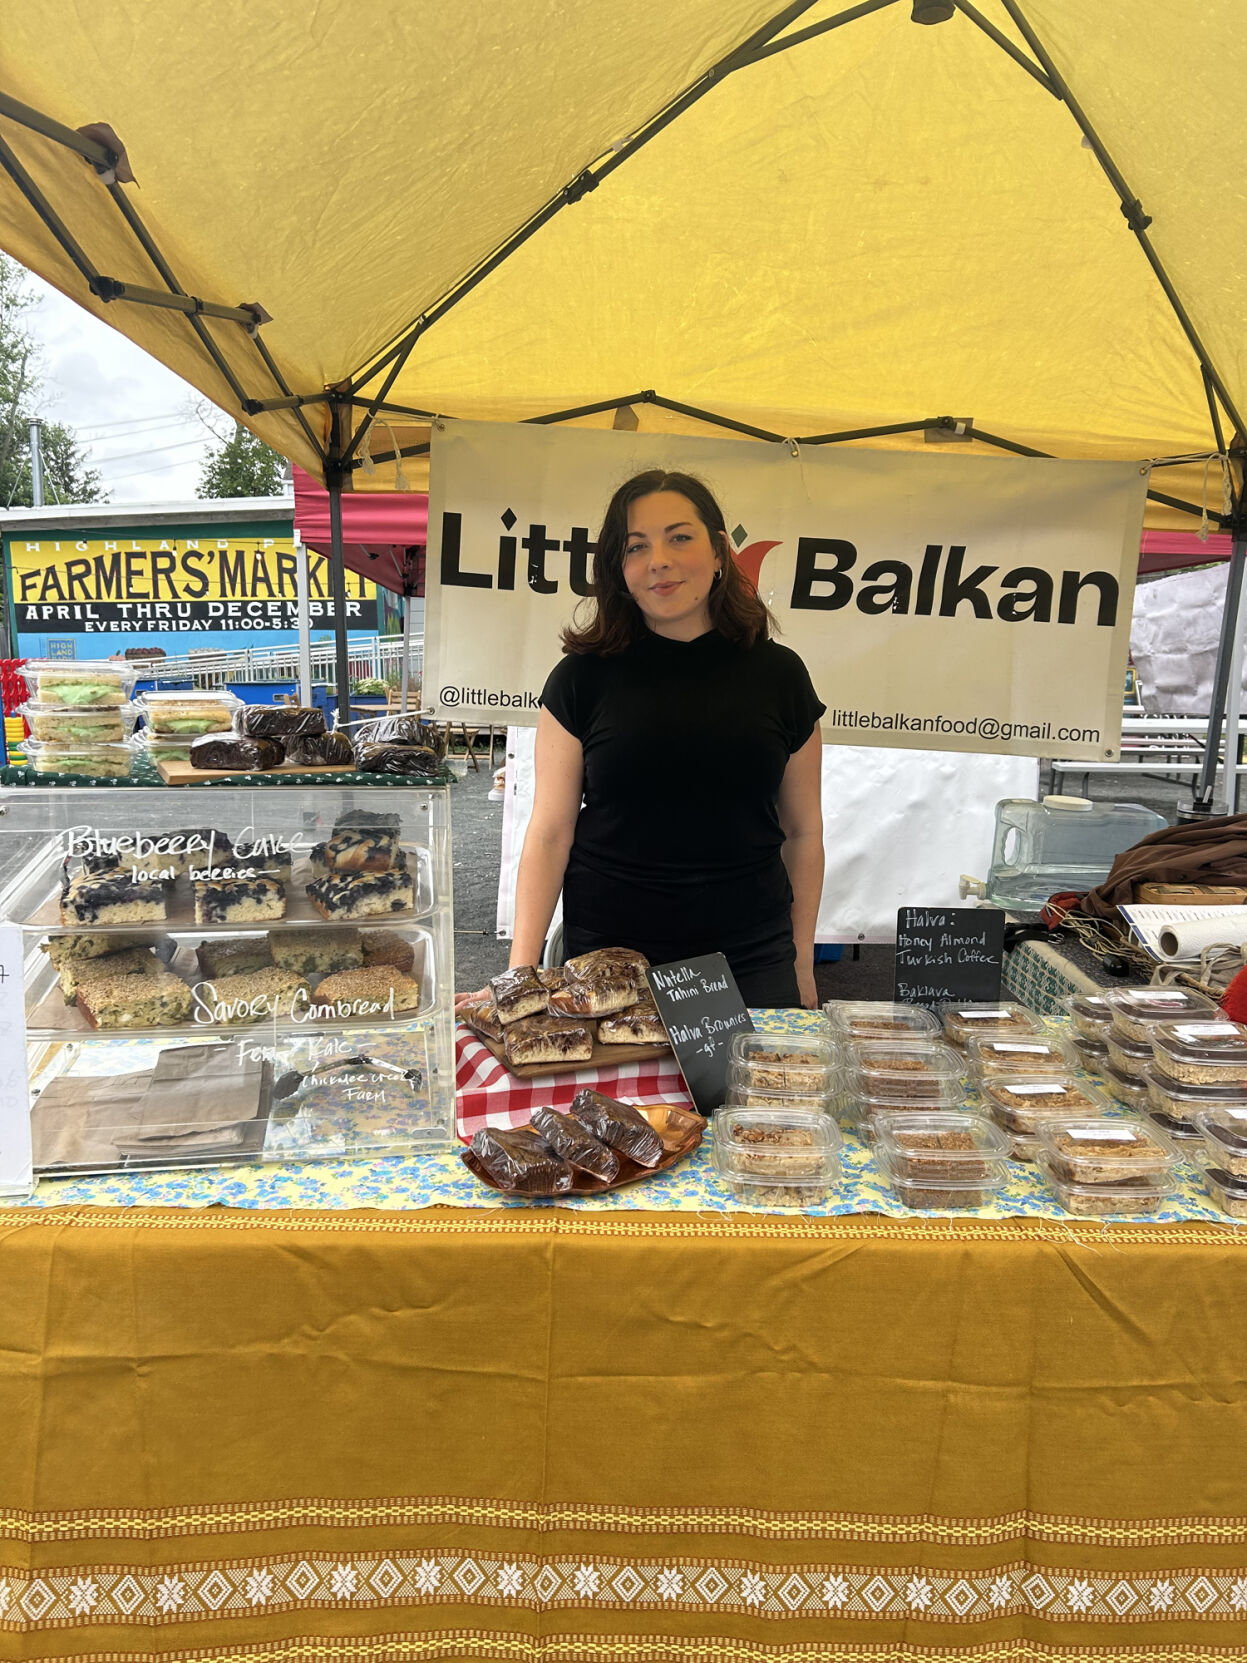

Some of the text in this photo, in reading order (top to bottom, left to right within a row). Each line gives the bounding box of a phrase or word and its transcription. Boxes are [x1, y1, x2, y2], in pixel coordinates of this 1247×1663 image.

[26, 539, 229, 552] HIGHLAND
[440, 507, 1120, 627] Litt Balkan
[26, 602, 362, 620] APRIL THRU DECEMBER
[84, 621, 142, 632] EVERY
[147, 619, 212, 631] FRIDAY
[440, 686, 1100, 743] @littlebalk littlebalkanfood@gmail.com
[231, 827, 312, 859] Cake
[131, 865, 175, 883] local
[898, 932, 986, 951] Honey Almond
[896, 947, 999, 966] Turkish Coffee
[652, 966, 701, 990] Nutella
[666, 974, 728, 1002] Tahini Bread
[898, 982, 955, 997] Baklava
[669, 1013, 747, 1045] Halva Brownies
